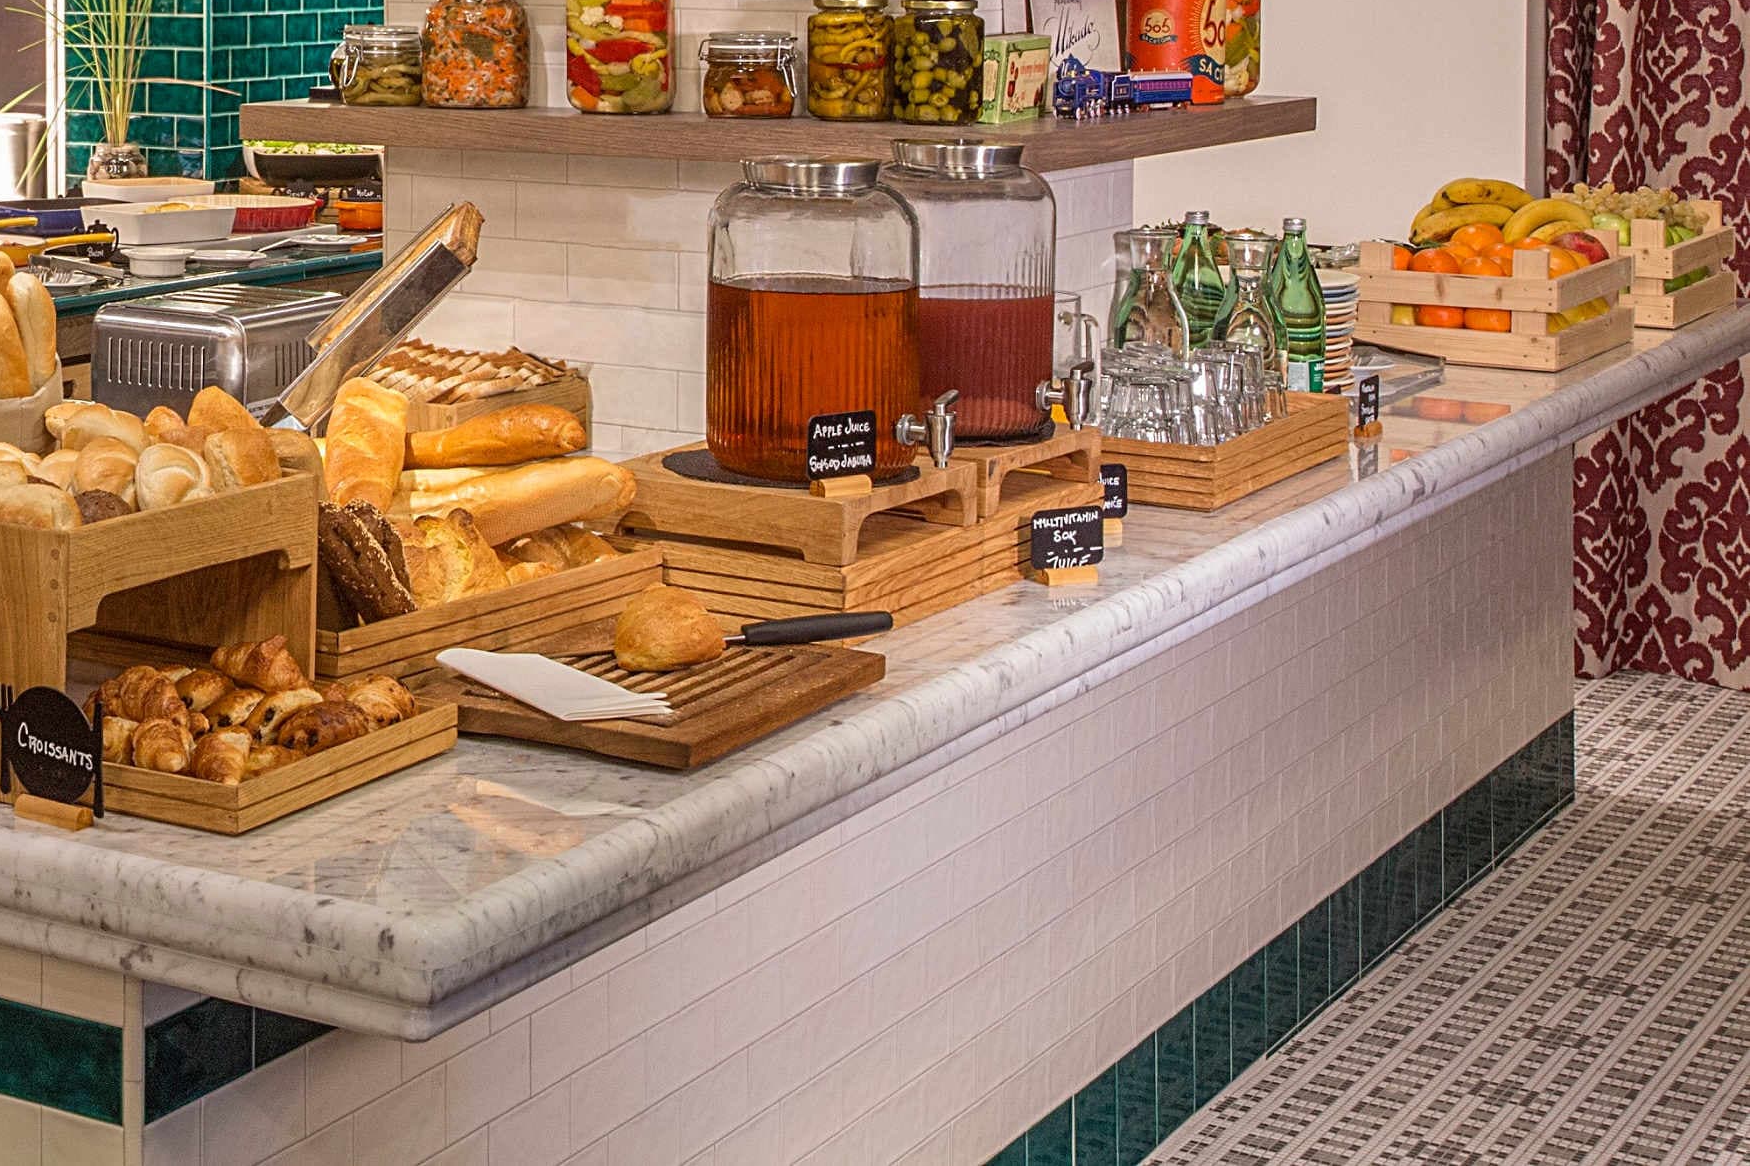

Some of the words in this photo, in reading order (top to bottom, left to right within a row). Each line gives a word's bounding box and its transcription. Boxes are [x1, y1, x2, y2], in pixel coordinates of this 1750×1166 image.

[1145, 18, 1170, 33] 505
[813, 424, 843, 439] APPLE
[844, 417, 870, 434] JUICE
[17, 721, 94, 771] CROISSANTS
